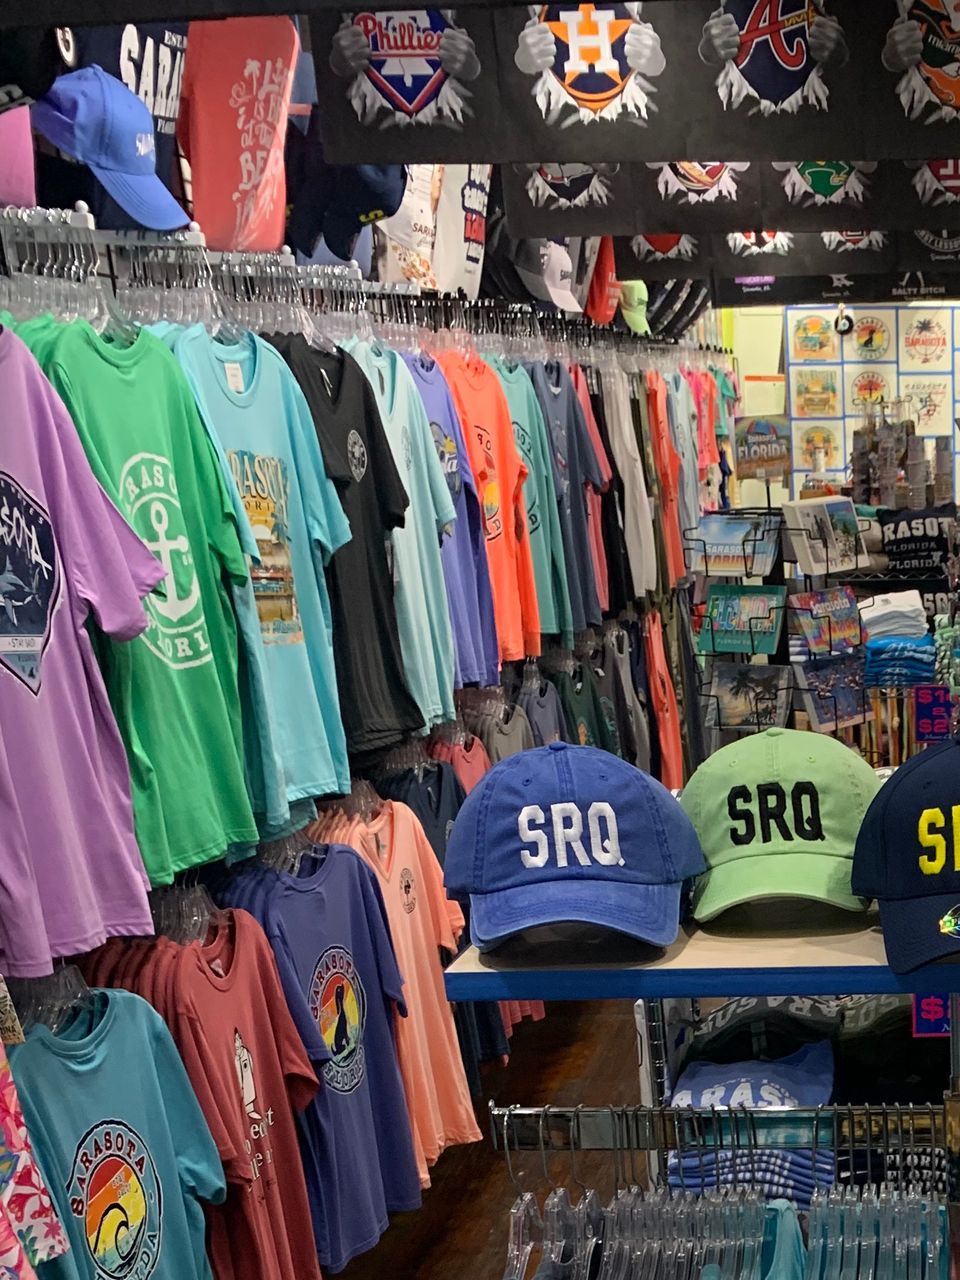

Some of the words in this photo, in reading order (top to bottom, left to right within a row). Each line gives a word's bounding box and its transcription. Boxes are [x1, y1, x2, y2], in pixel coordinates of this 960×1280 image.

[559, 9, 620, 73] H
[517, 802, 626, 869] SRQ
[726, 781, 825, 847] SRQ
[70, 1130, 147, 1217] SARASOTA
